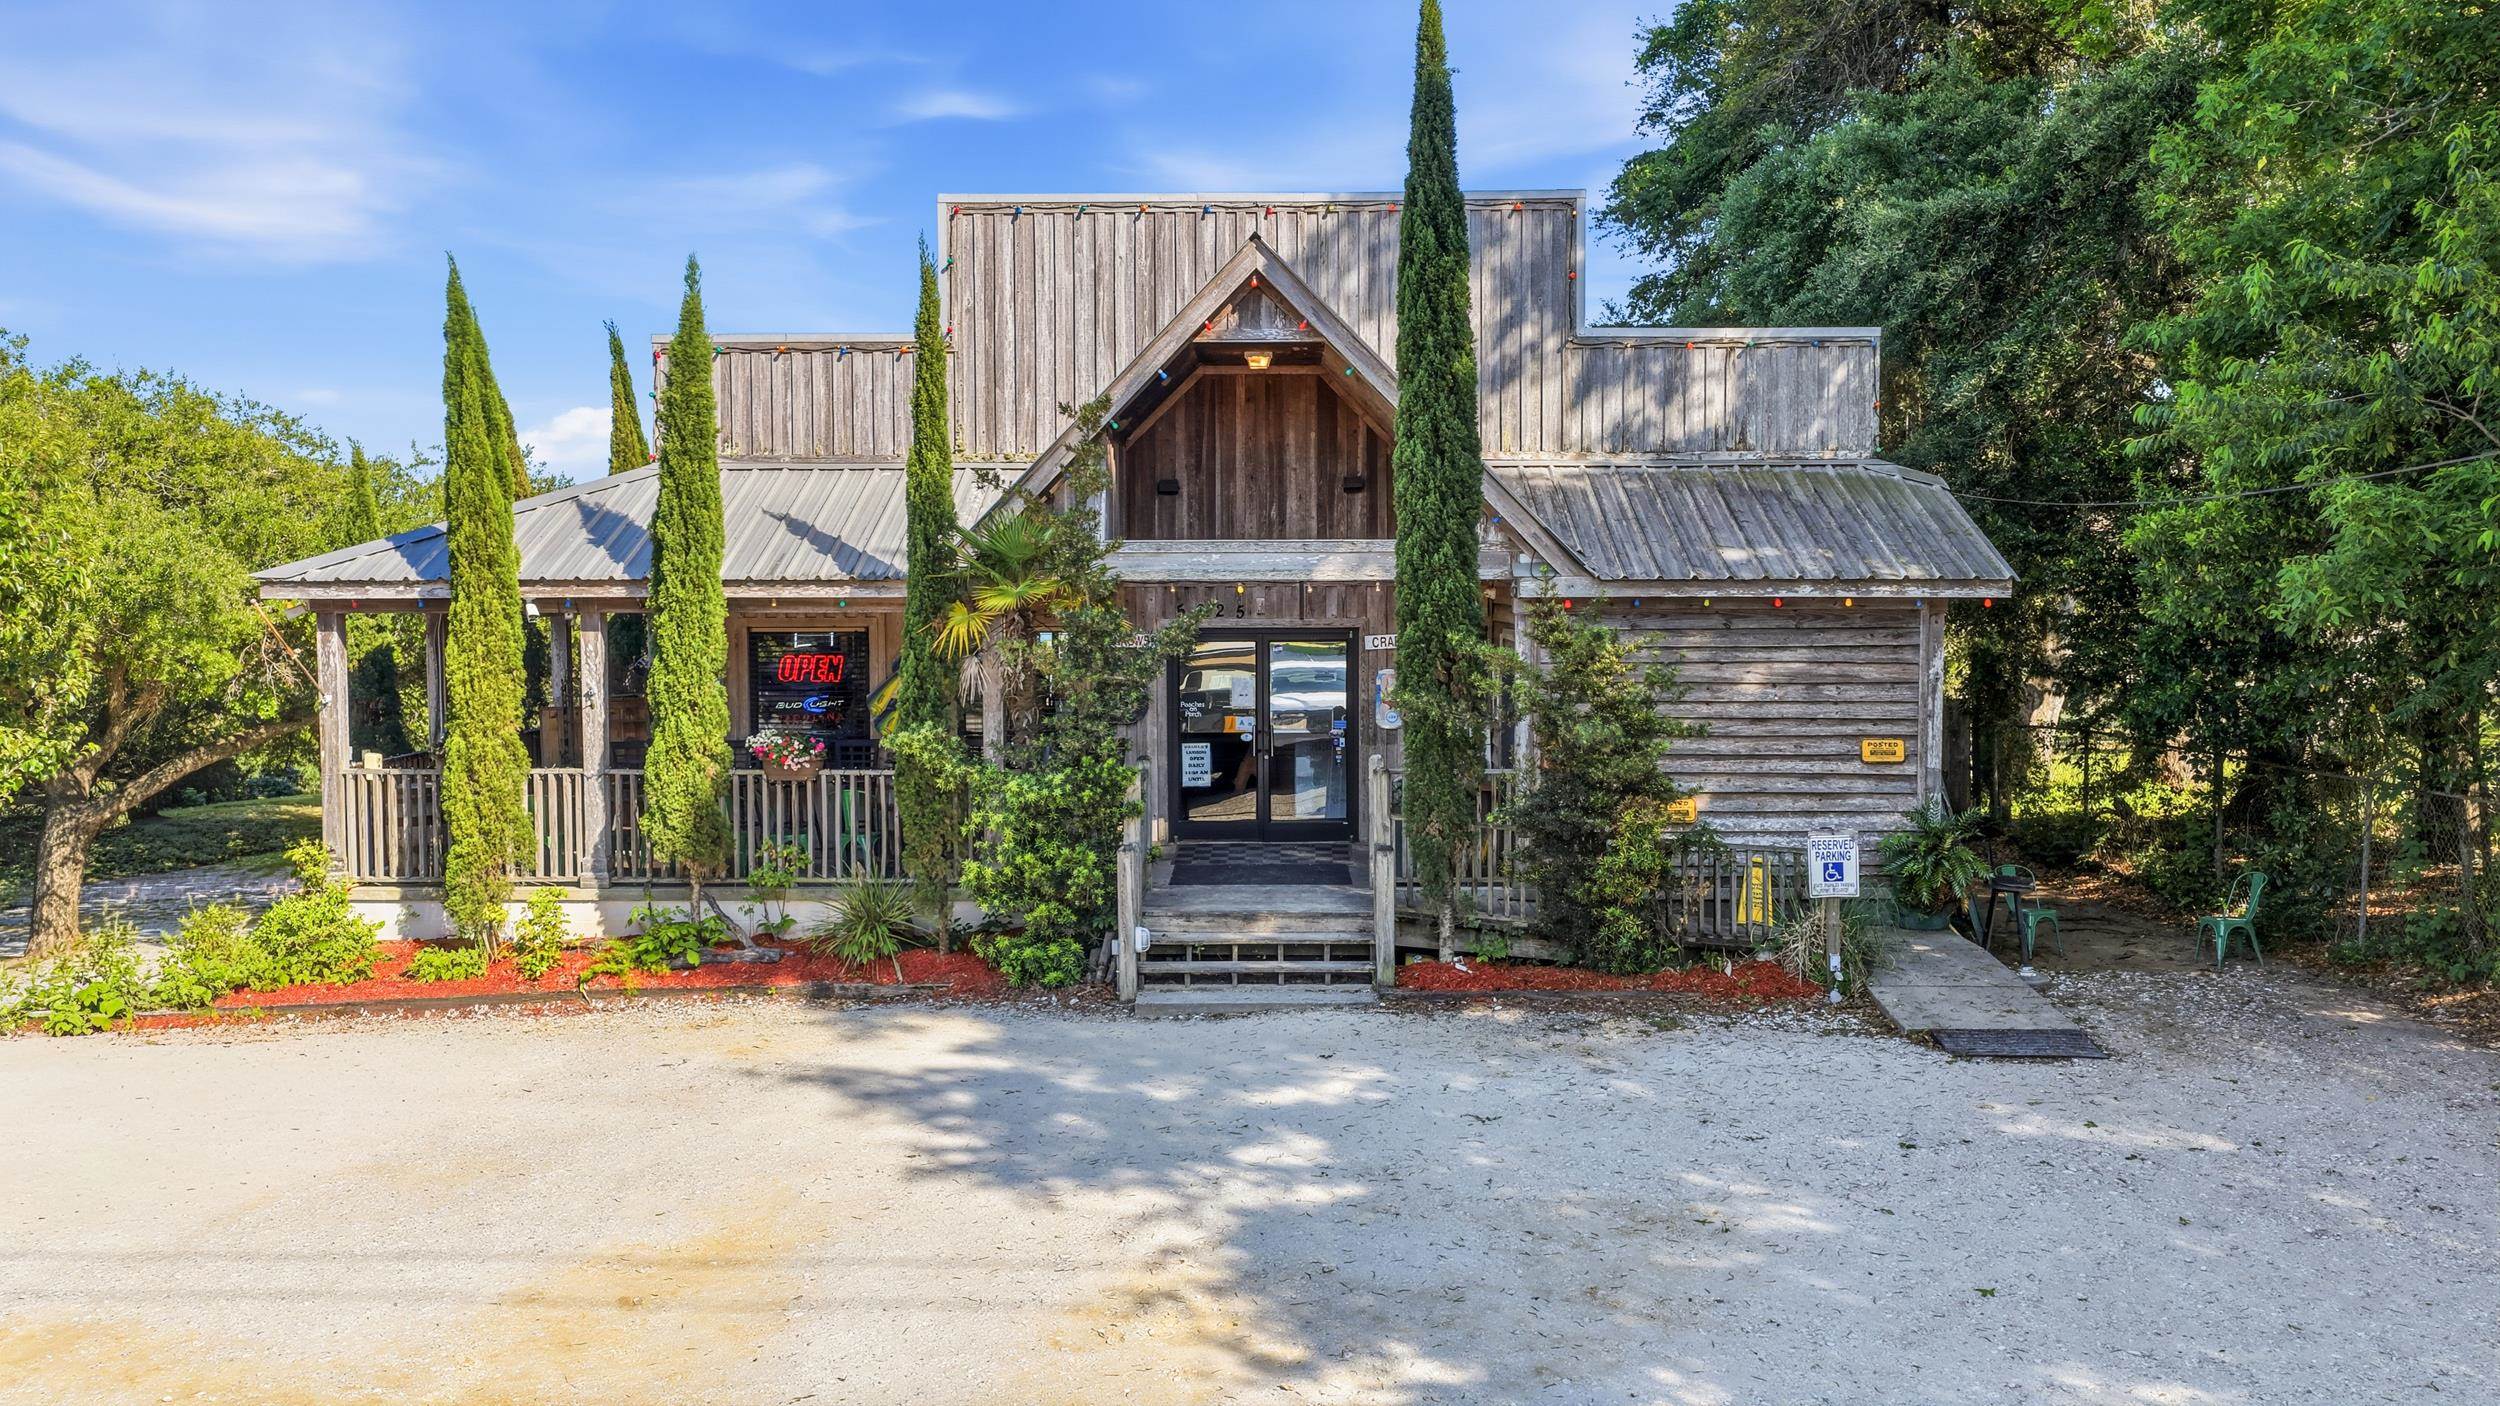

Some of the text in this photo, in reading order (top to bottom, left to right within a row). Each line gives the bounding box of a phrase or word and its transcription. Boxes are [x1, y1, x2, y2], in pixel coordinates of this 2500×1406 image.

[778, 655, 844, 682] OPEN
[775, 701, 803, 709] BUD
[1811, 839, 1855, 850] RESERVED
[1815, 850, 1852, 861] PARKING
